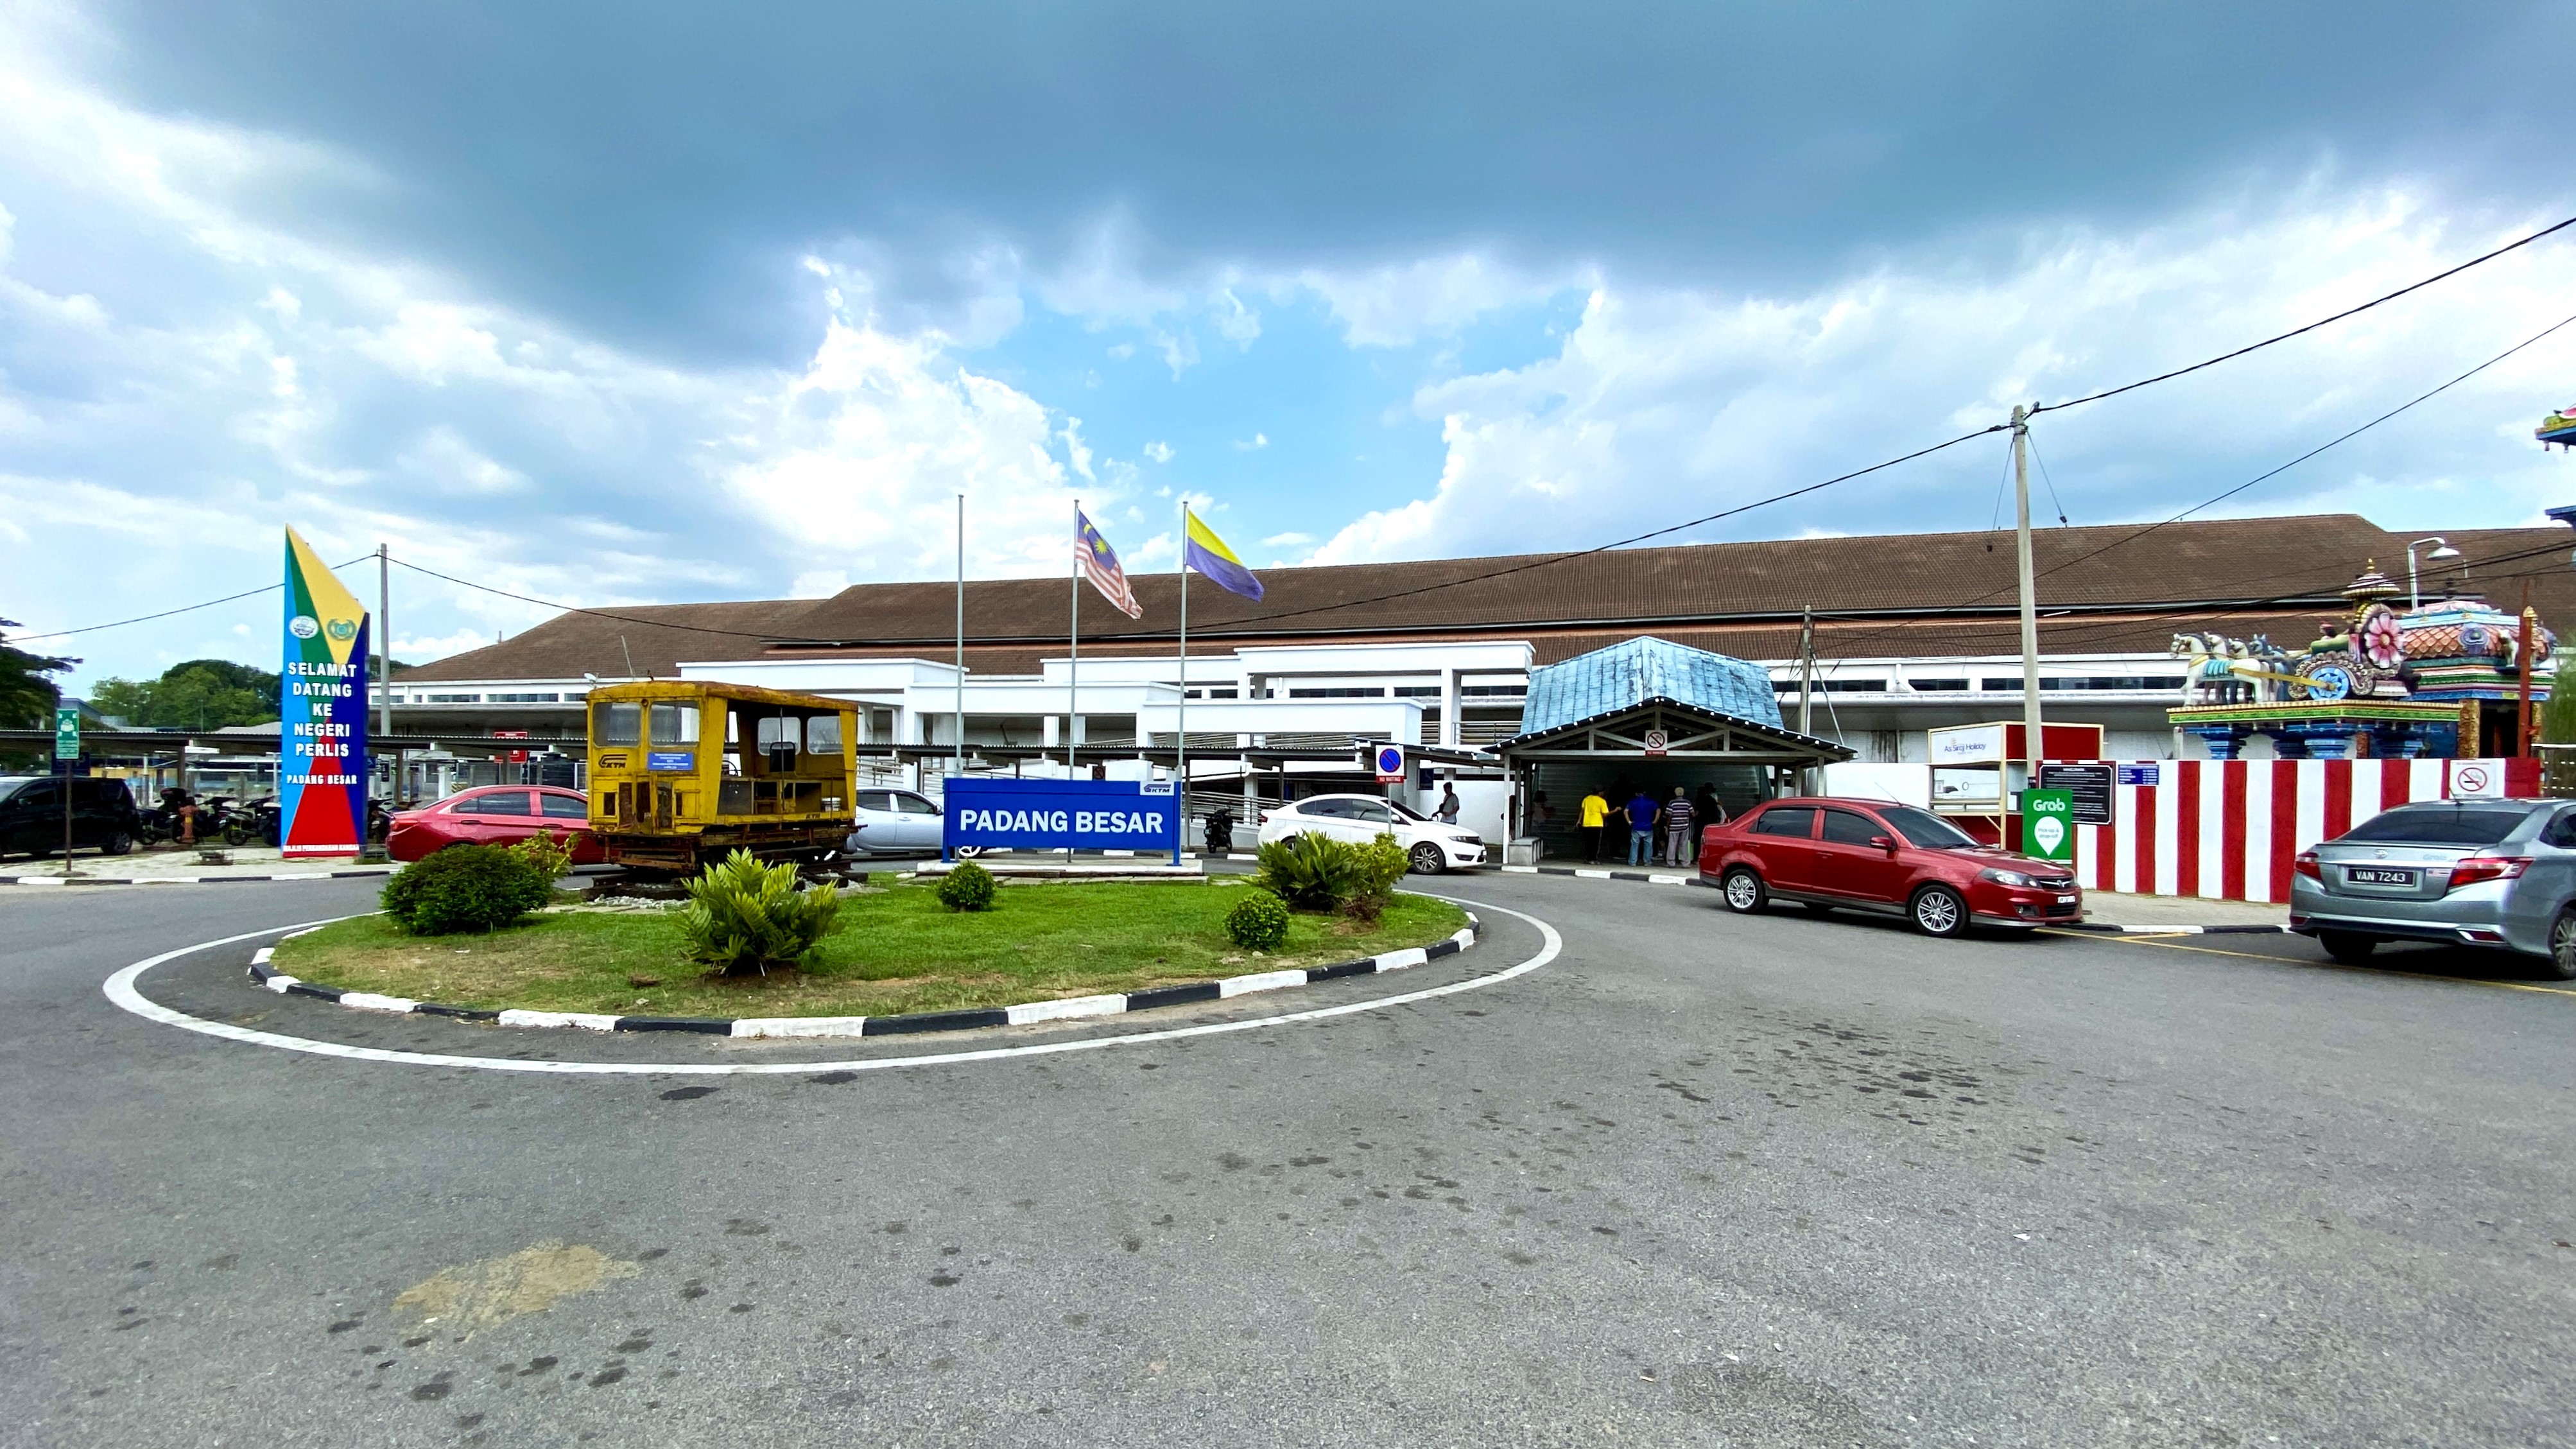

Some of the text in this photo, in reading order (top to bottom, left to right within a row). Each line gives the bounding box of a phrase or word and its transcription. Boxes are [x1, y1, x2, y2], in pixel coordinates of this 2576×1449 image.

[288, 661, 358, 677] SELAMAT
[293, 682, 352, 698] DATANG
[313, 702, 333, 716] KE
[294, 722, 350, 737] NEGERI
[295, 743, 349, 757] PERLIS
[286, 774, 358, 785] PADANG BESAR
[2032, 797, 2066, 811] Grab
[960, 809, 1163, 834] PADANG BESAR
[2355, 870, 2406, 883] VAN 7243
